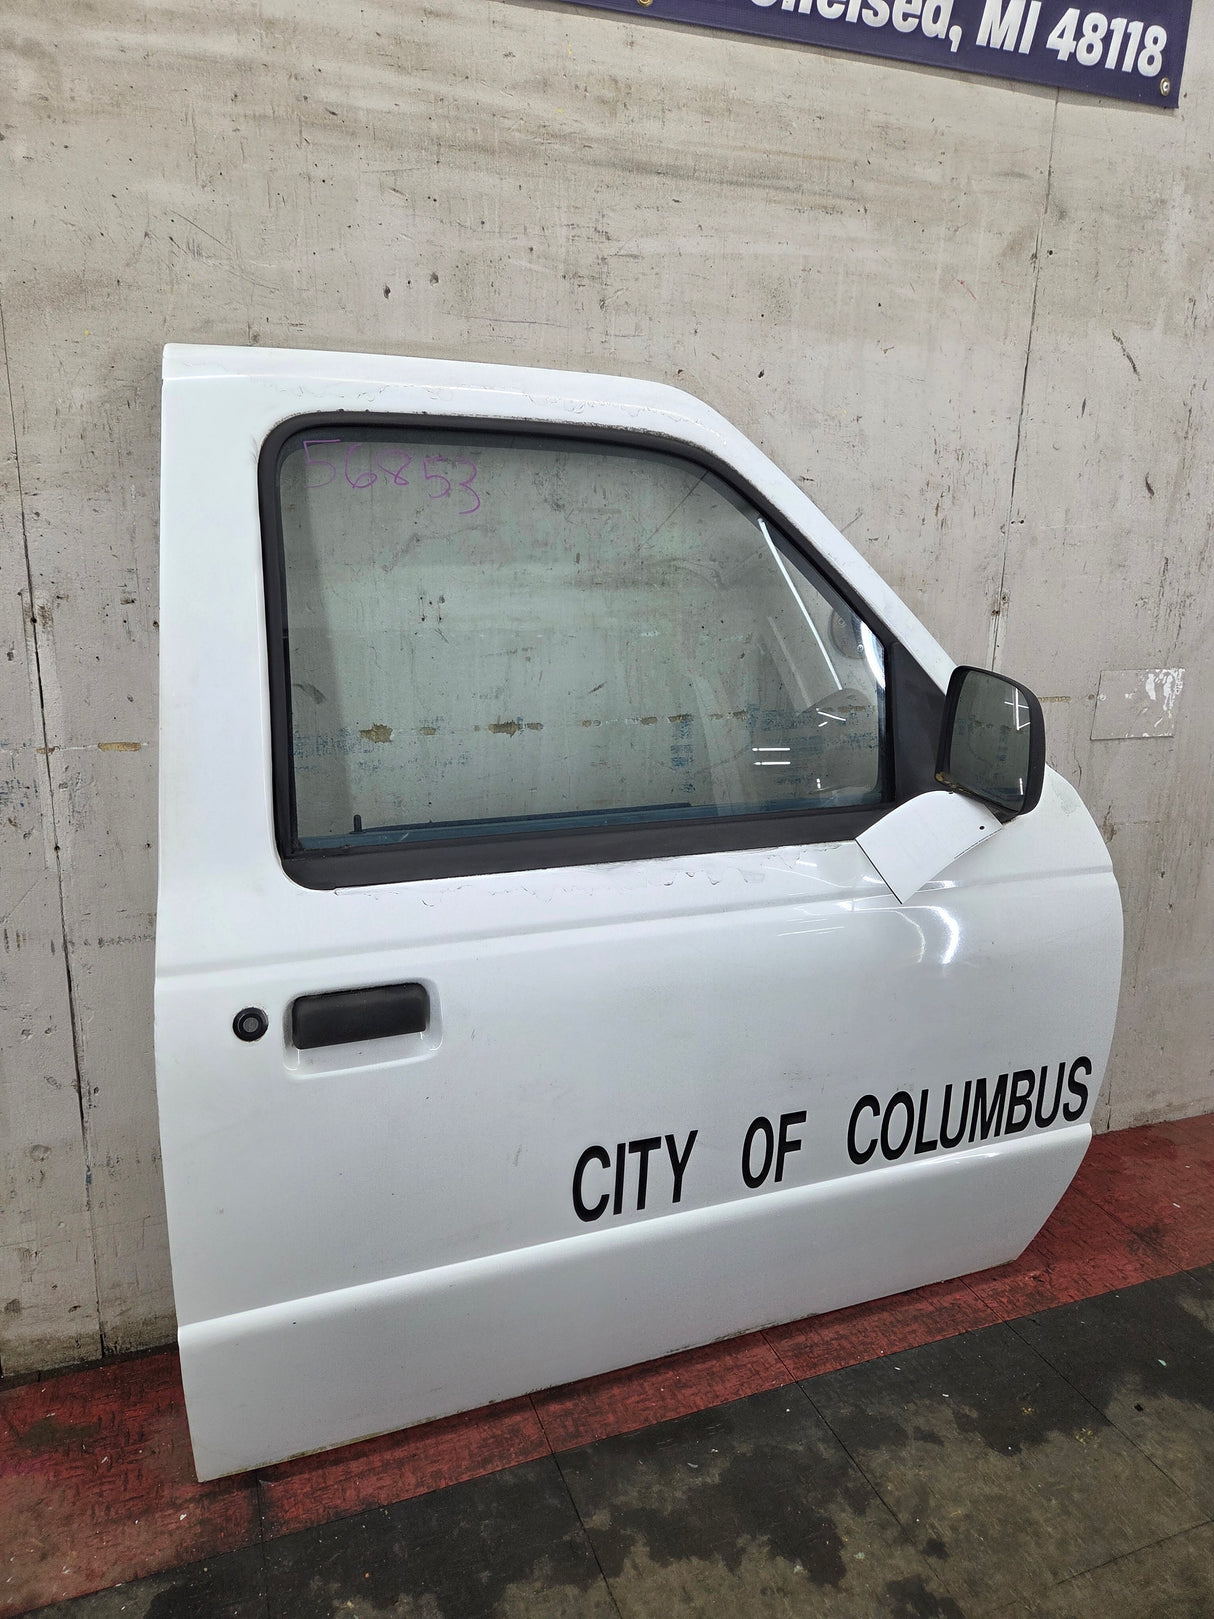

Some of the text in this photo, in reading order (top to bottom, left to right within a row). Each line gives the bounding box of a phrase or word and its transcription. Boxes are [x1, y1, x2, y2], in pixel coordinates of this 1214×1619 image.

[975, 0, 1042, 55] MI
[1045, 7, 1167, 78] 48118
[303, 439, 481, 514] 56853
[572, 1056, 1092, 1222] CITY OF COLUMBUS
